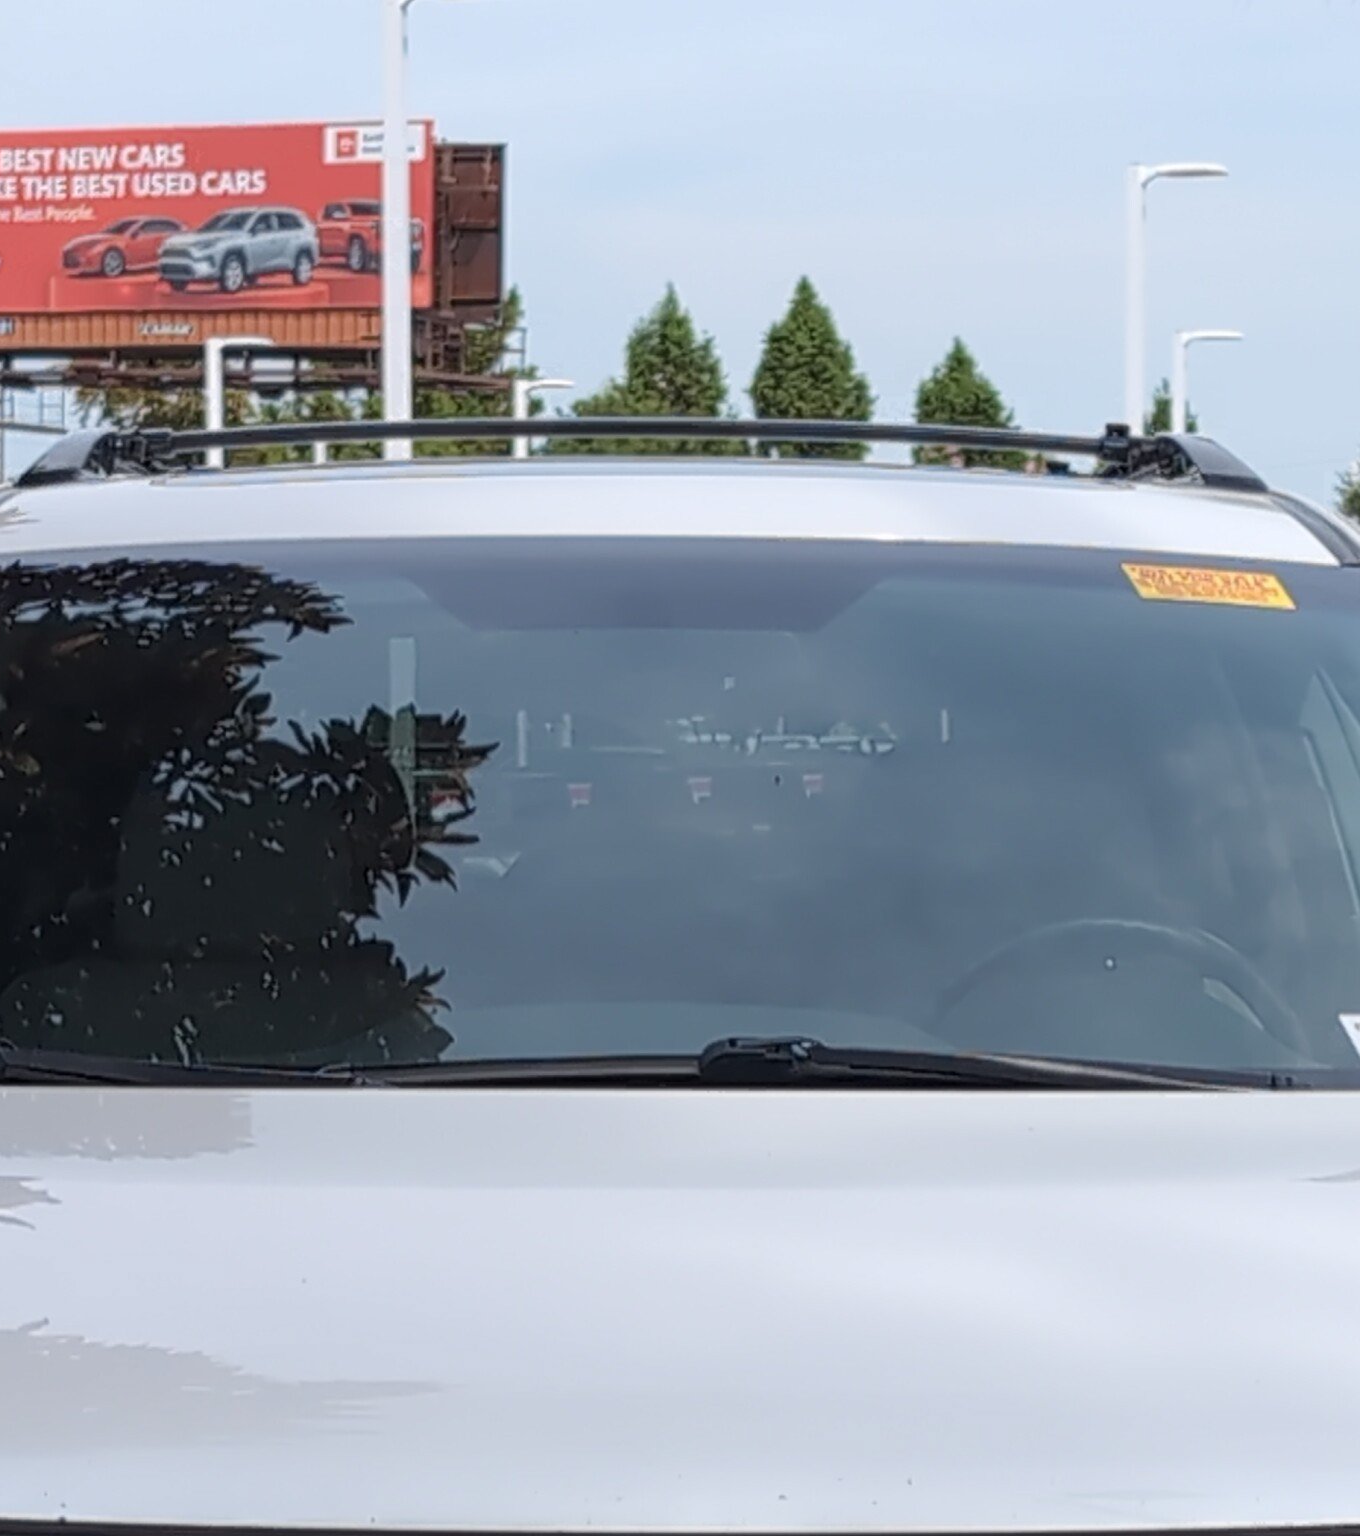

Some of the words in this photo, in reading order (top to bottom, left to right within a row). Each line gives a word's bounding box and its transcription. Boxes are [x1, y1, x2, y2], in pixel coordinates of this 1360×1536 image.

[57, 145, 117, 170] NEW
[119, 143, 185, 169] CARS
[21, 175, 67, 200] THE
[70, 172, 128, 199] BEST
[131, 171, 197, 197] USED
[200, 168, 267, 196] CARS
